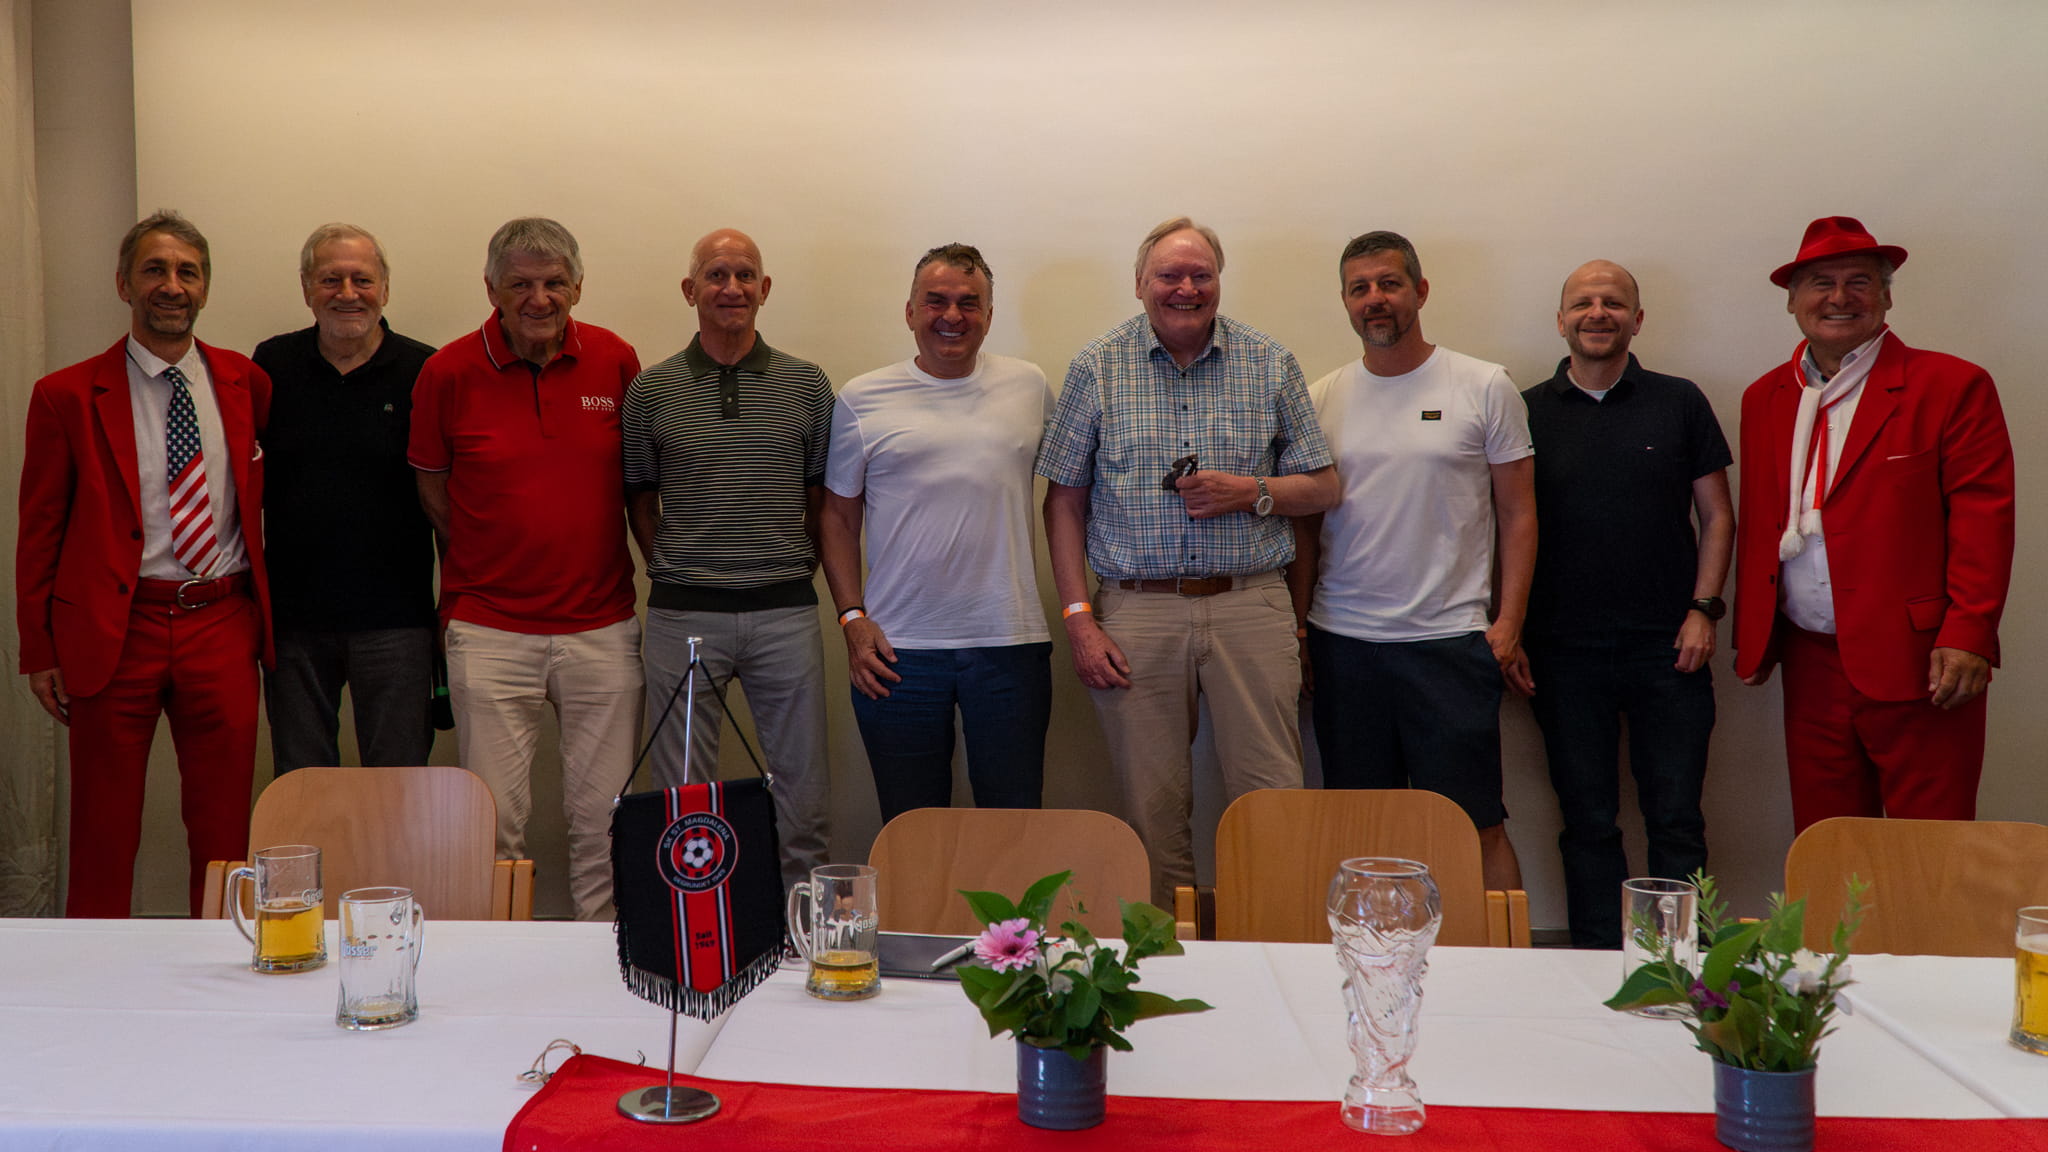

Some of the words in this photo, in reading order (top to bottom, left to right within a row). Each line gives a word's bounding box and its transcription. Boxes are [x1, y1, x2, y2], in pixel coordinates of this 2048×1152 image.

[580, 396, 615, 408] BOSS
[663, 836, 673, 849] SK
[684, 816, 730, 841] MAGDALENA
